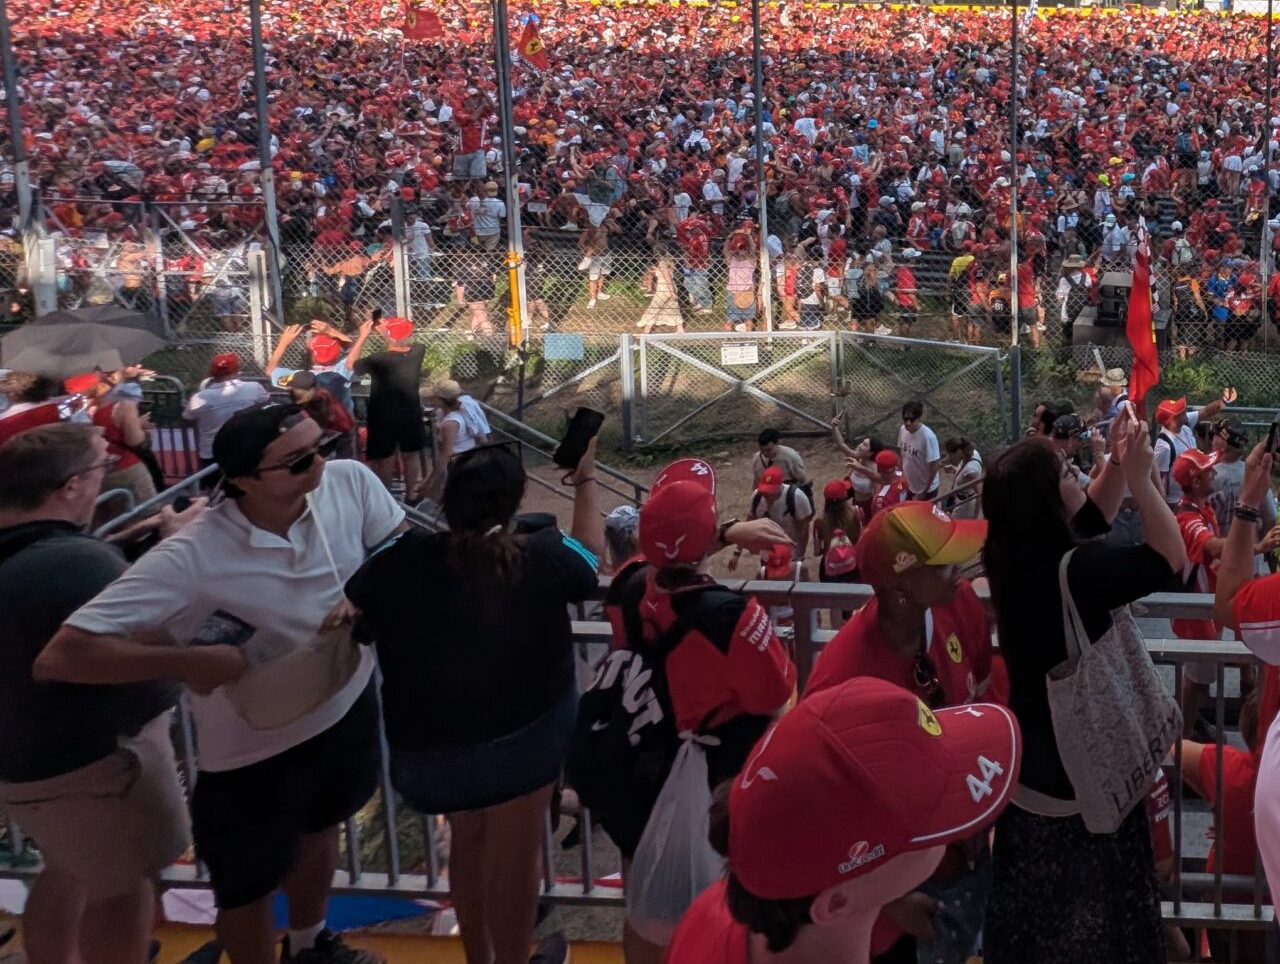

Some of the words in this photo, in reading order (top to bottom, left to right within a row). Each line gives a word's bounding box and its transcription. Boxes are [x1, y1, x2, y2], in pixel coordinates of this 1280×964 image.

[966, 755, 1004, 804] 44
[1112, 707, 1178, 814] LIBERTY
[838, 844, 886, 874] UniCredit
